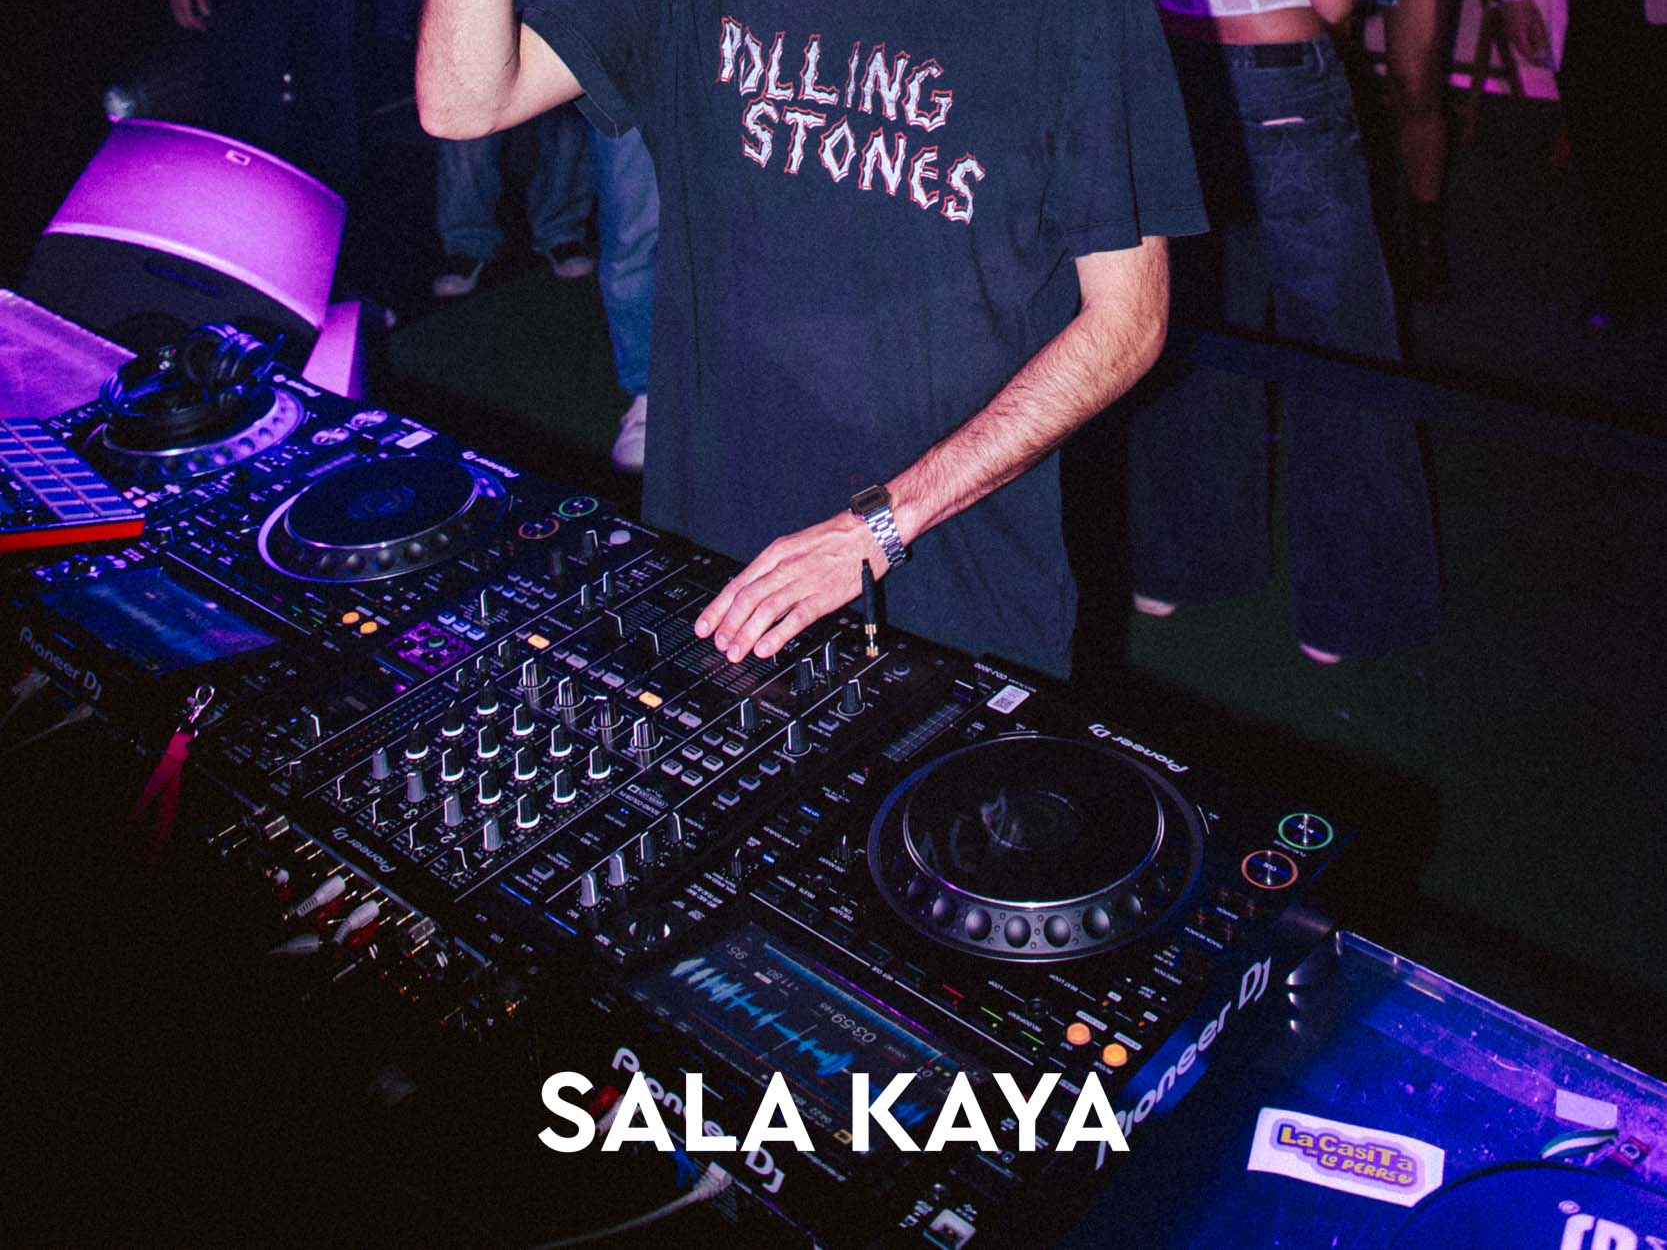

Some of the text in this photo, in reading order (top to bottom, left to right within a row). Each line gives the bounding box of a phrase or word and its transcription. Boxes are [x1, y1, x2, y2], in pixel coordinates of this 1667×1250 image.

[741, 96, 986, 226] STONES
[1088, 723, 1190, 773] Pioneer DJ
[346, 838, 397, 873] Pioneer
[1237, 956, 1271, 1010] DJ
[1280, 1126, 1313, 1147] La
